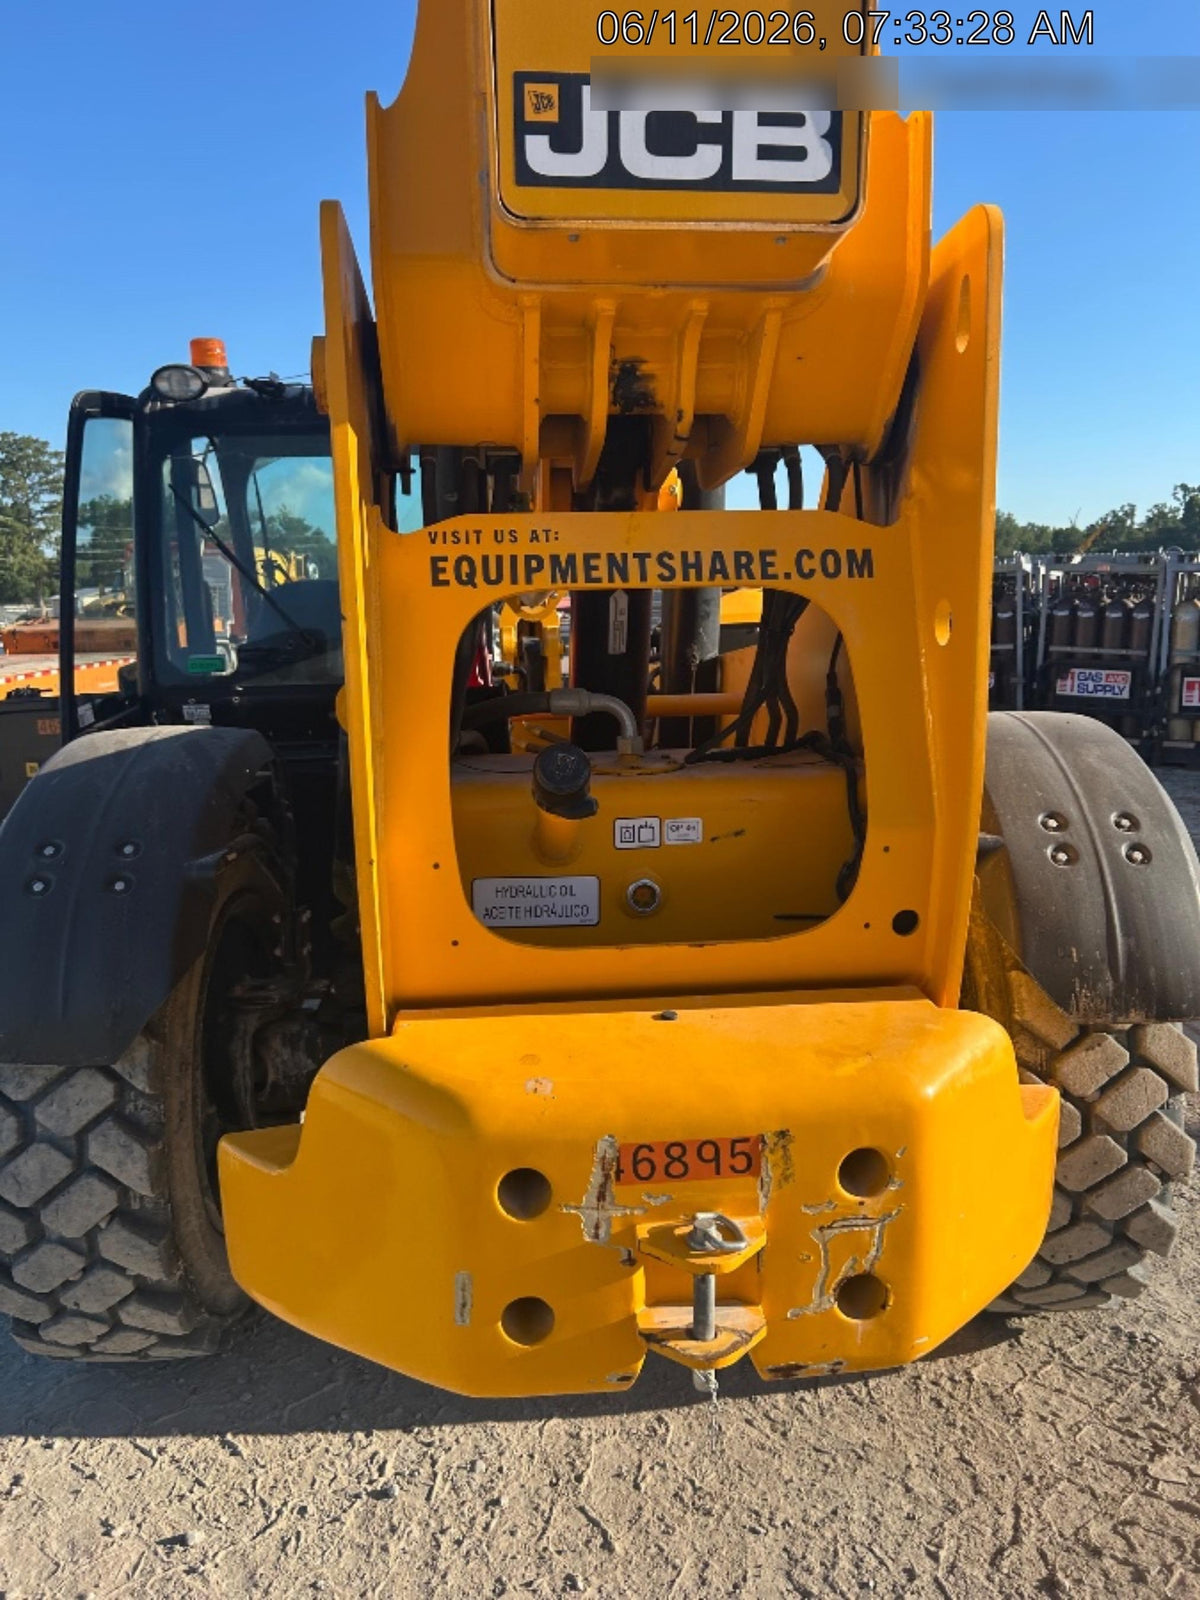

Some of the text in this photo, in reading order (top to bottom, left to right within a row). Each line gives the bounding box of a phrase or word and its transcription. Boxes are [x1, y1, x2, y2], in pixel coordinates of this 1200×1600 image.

[524, 85, 834, 182] JCB
[428, 529, 559, 545] VISIT US AT:
[430, 548, 875, 588] EQUIPMENTSHARE.COM
[1077, 671, 1103, 683] GAS
[1077, 683, 1126, 696] SUPPLY
